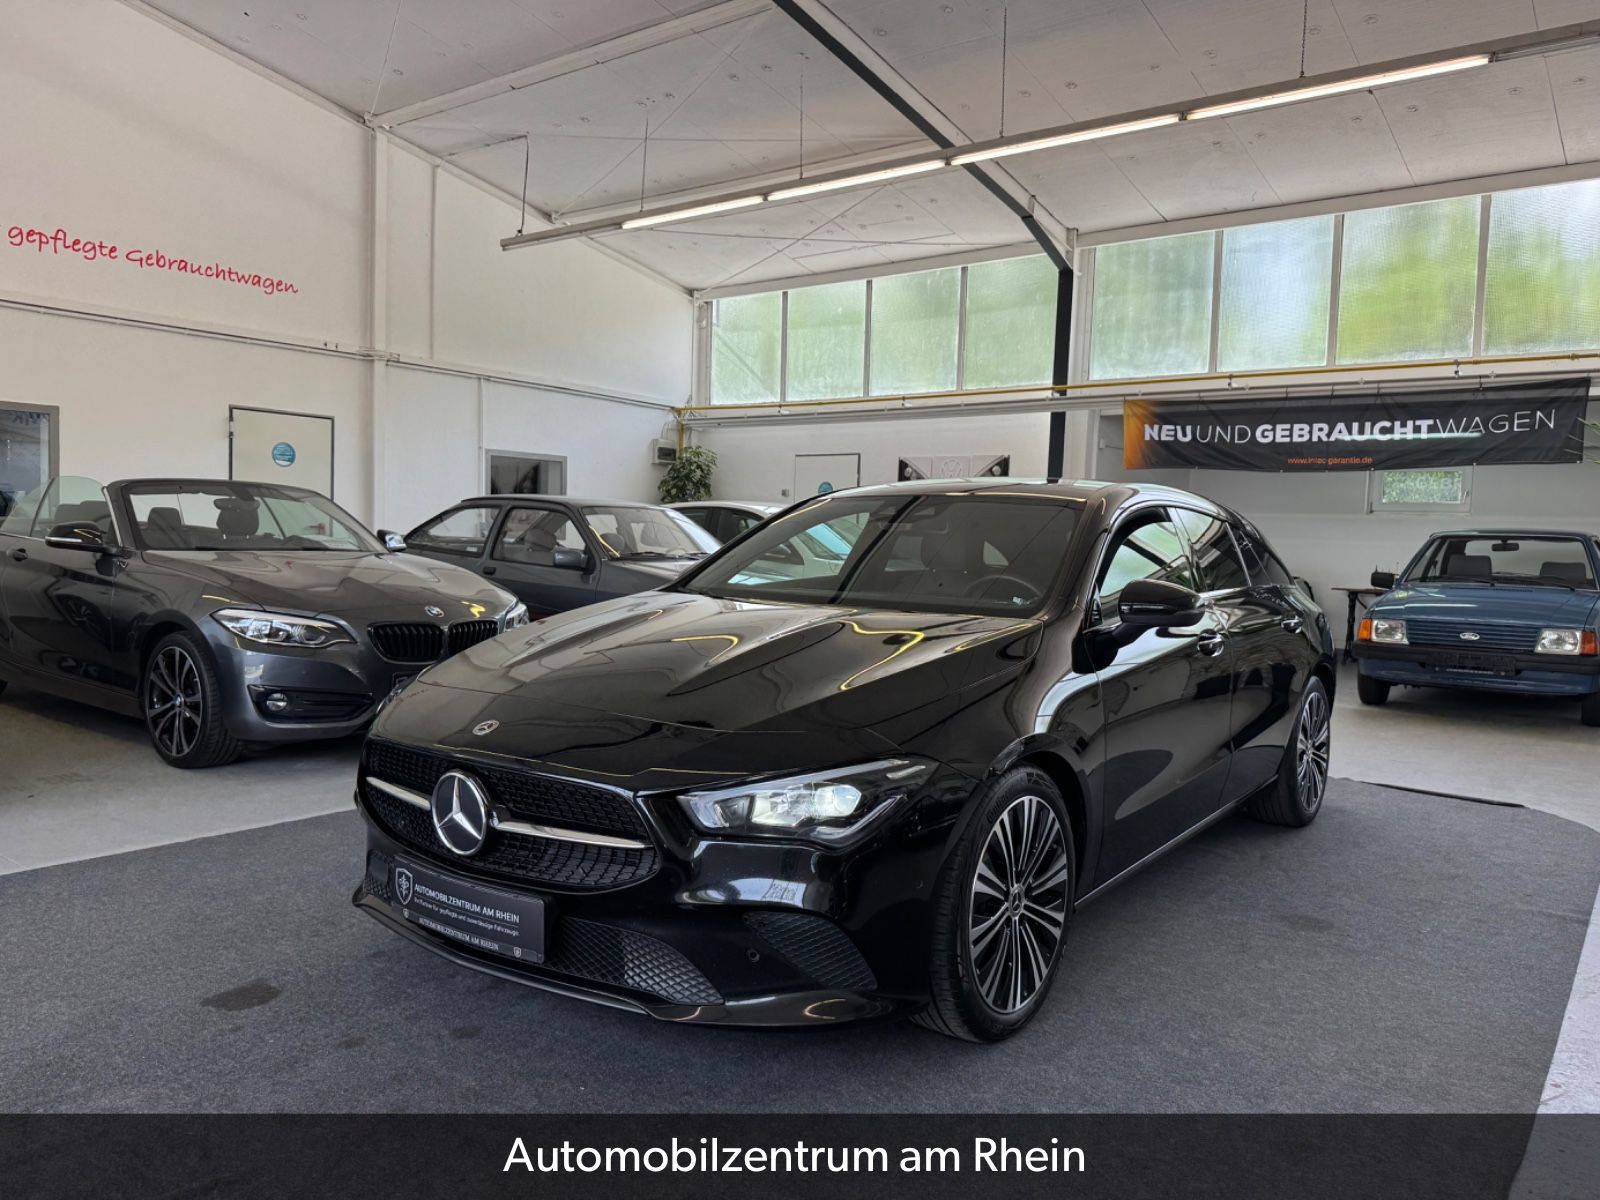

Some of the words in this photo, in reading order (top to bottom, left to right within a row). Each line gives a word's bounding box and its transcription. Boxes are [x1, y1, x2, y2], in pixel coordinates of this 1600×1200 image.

[7, 225, 118, 260] gepflegte
[124, 249, 298, 295] Gebrauchtwagen
[415, 884, 481, 913] AUTOMOBILZENTRUM
[482, 906, 494, 918] AM
[496, 909, 520, 924] RHEIN
